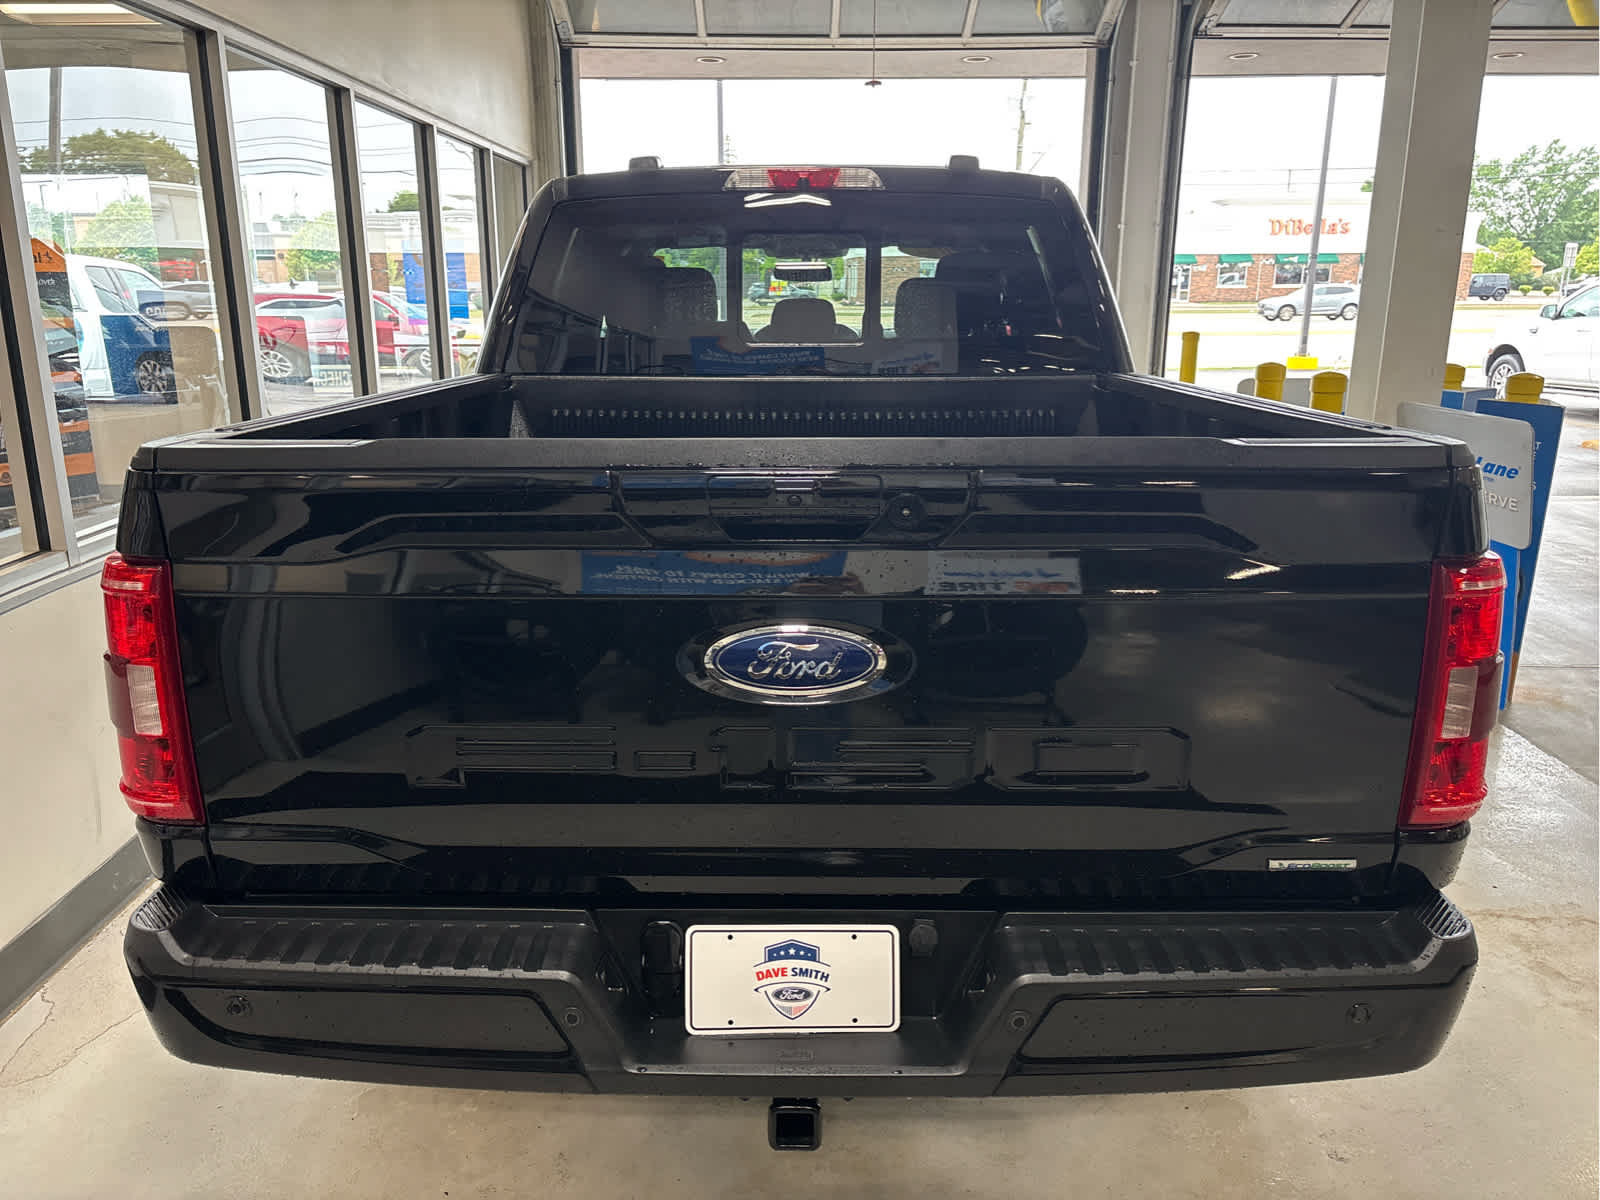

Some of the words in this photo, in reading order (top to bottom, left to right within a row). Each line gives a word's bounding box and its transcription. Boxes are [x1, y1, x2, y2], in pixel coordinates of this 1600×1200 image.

[1268, 218, 1352, 236] DiBela's
[748, 641, 844, 681] Ford
[405, 724, 1191, 791] F-150
[755, 967, 788, 982] DAVE
[791, 967, 830, 983] SMITH
[779, 989, 807, 1000] Ford
